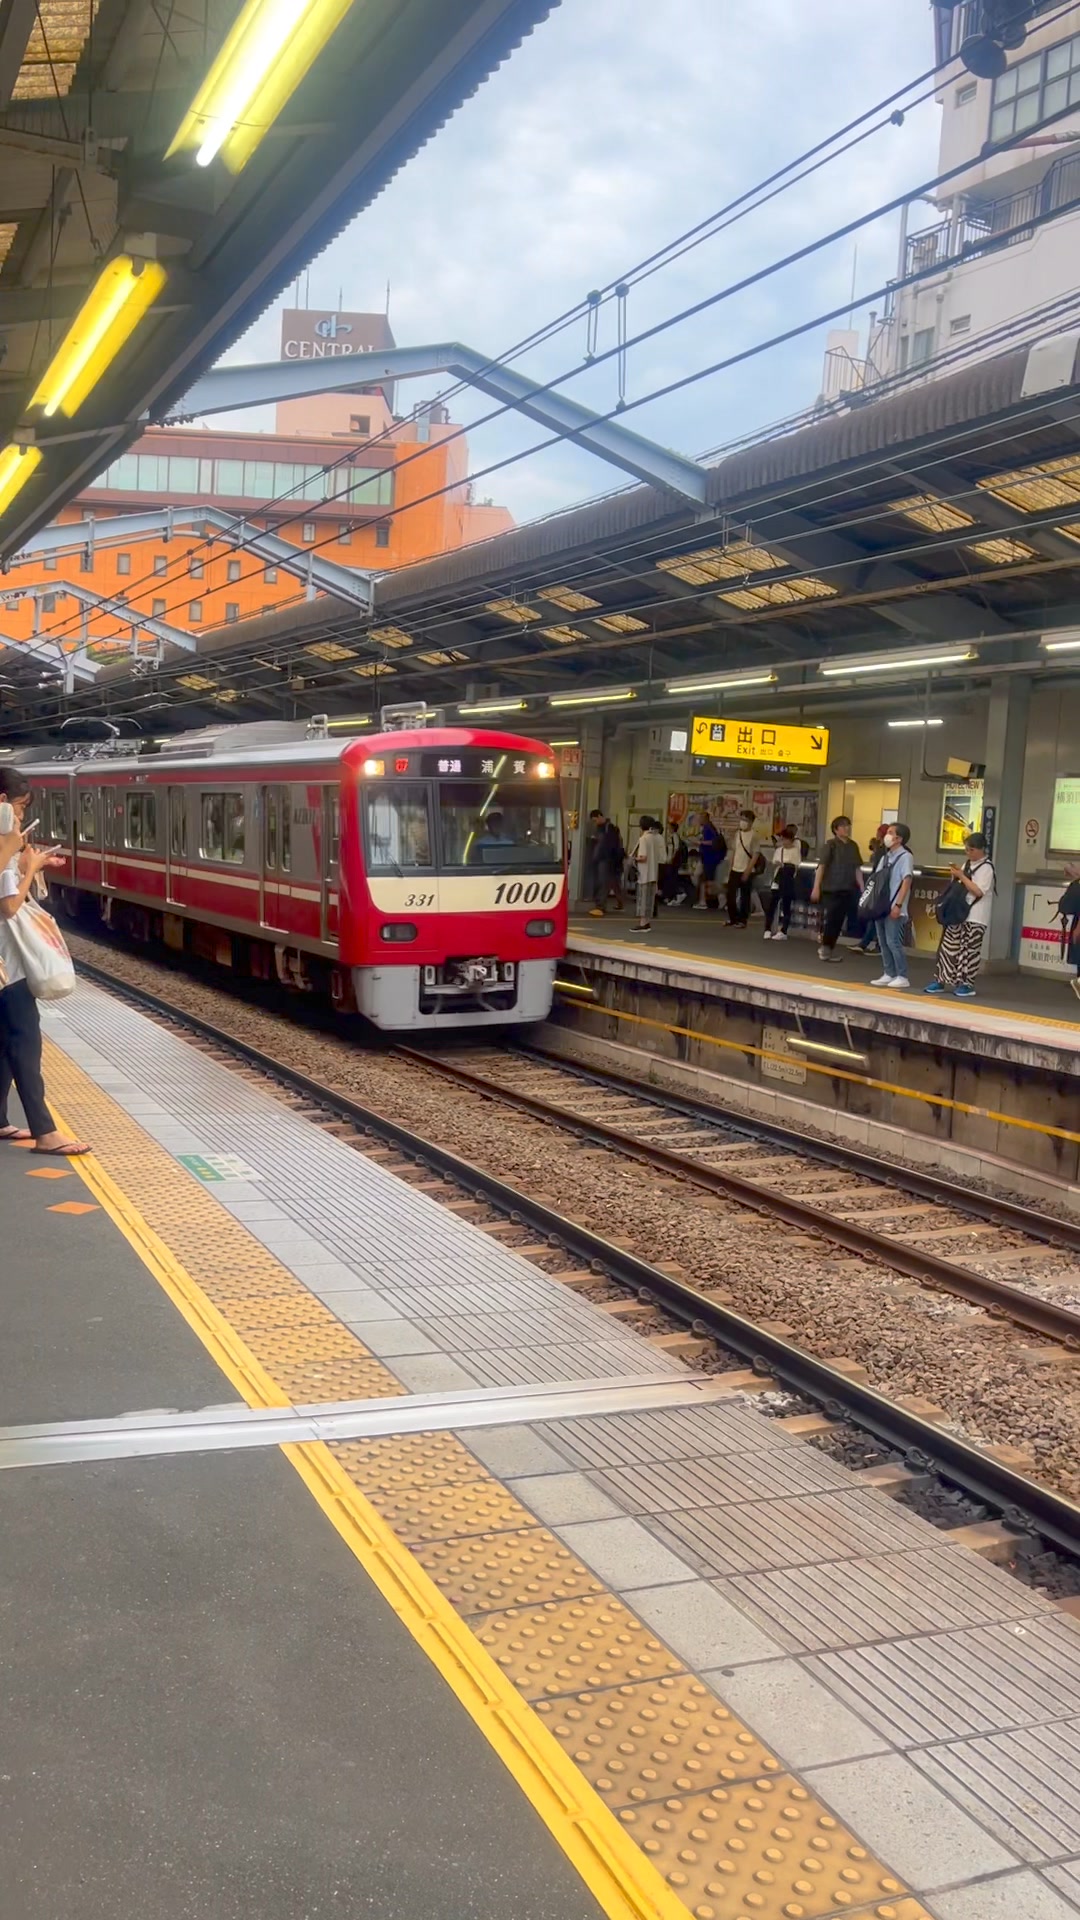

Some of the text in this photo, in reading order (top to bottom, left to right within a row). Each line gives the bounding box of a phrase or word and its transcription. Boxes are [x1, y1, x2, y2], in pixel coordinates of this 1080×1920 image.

[737, 726, 776, 746] 出口
[736, 744, 756, 756] Exit
[437, 759, 462, 773] 普通
[404, 882, 557, 907] 331 1000
